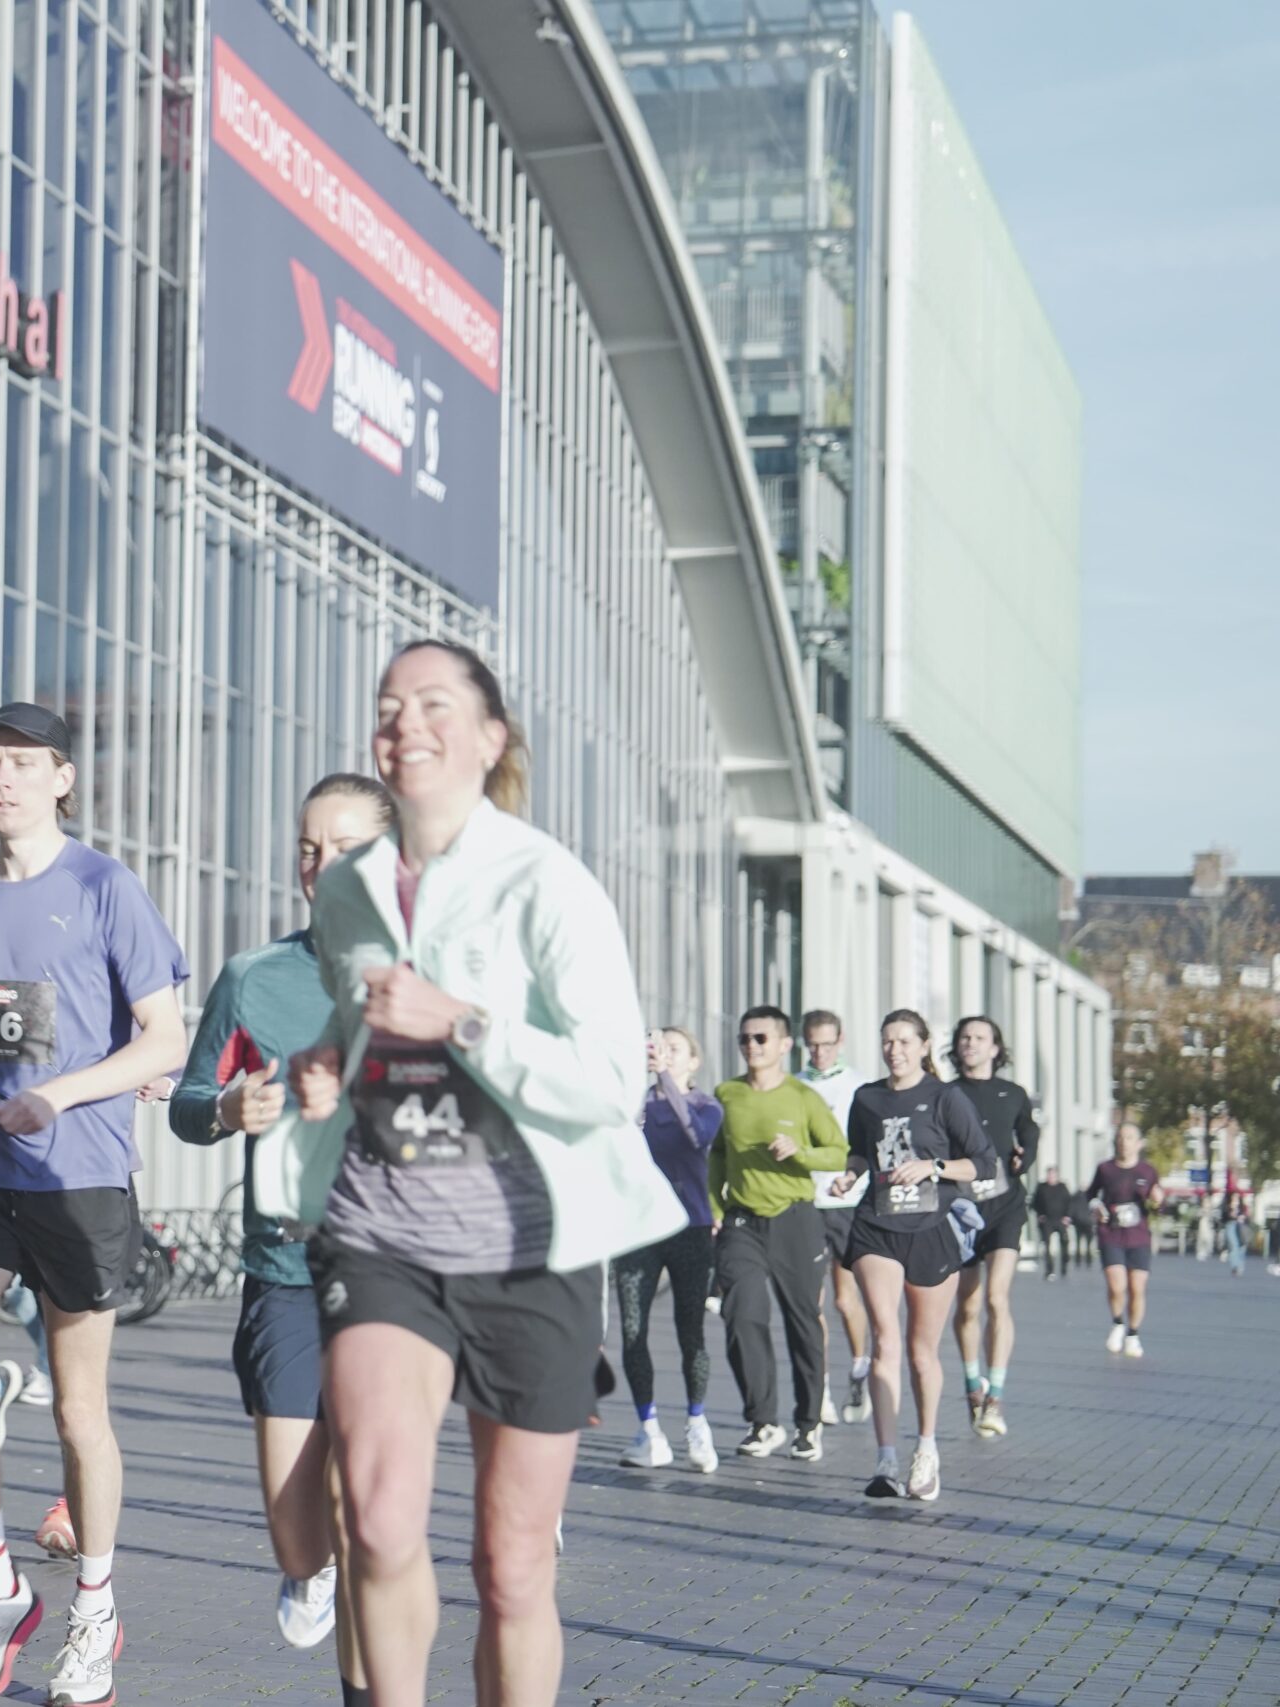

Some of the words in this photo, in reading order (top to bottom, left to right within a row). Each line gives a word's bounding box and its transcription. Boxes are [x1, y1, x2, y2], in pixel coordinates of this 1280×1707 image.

[217, 65, 292, 181] WELCOME
[292, 140, 314, 199] TO
[313, 160, 341, 225] THE
[340, 186, 426, 305] INTERNATIONAL
[333, 322, 416, 449] RUNNING
[392, 1093, 465, 1138] 44
[890, 1184, 920, 1203] 52
